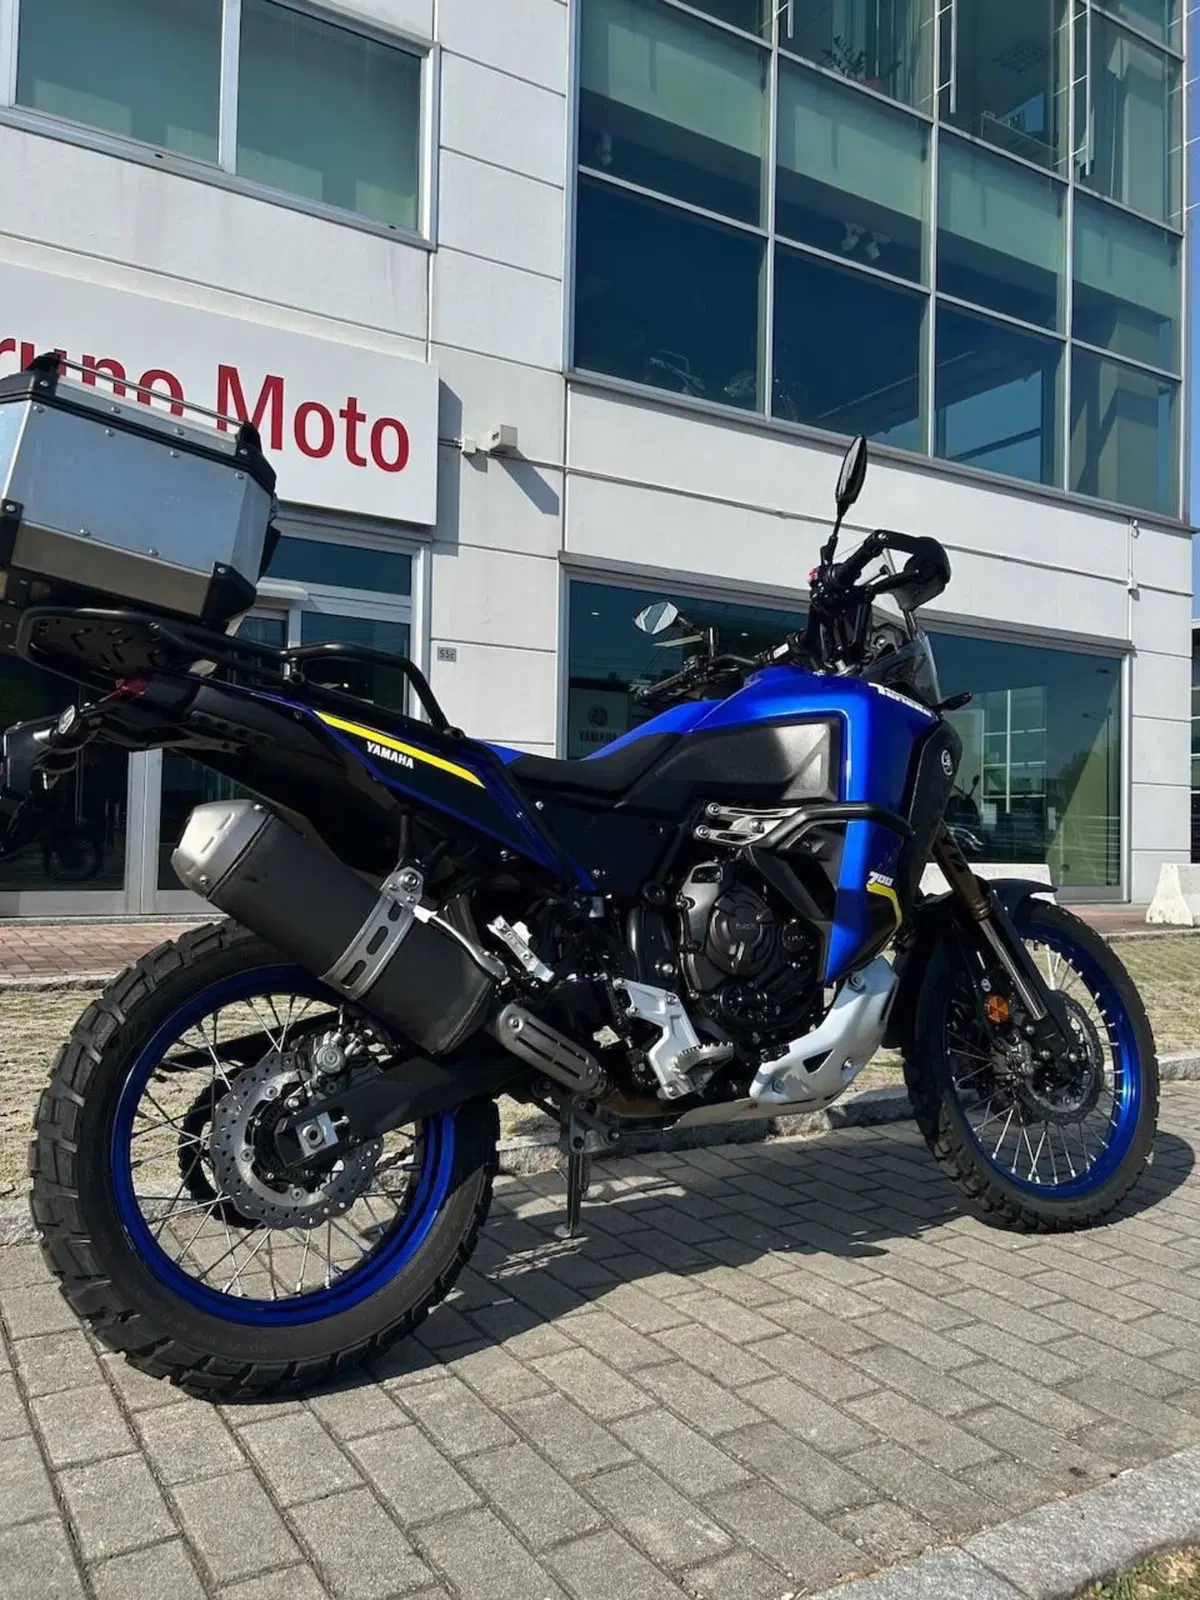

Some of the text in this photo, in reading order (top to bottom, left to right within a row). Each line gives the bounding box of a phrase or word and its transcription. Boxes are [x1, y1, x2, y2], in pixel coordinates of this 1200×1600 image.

[216, 364, 410, 473] Moto
[366, 741, 414, 769] YAMAHA
[867, 870, 894, 887] 700
